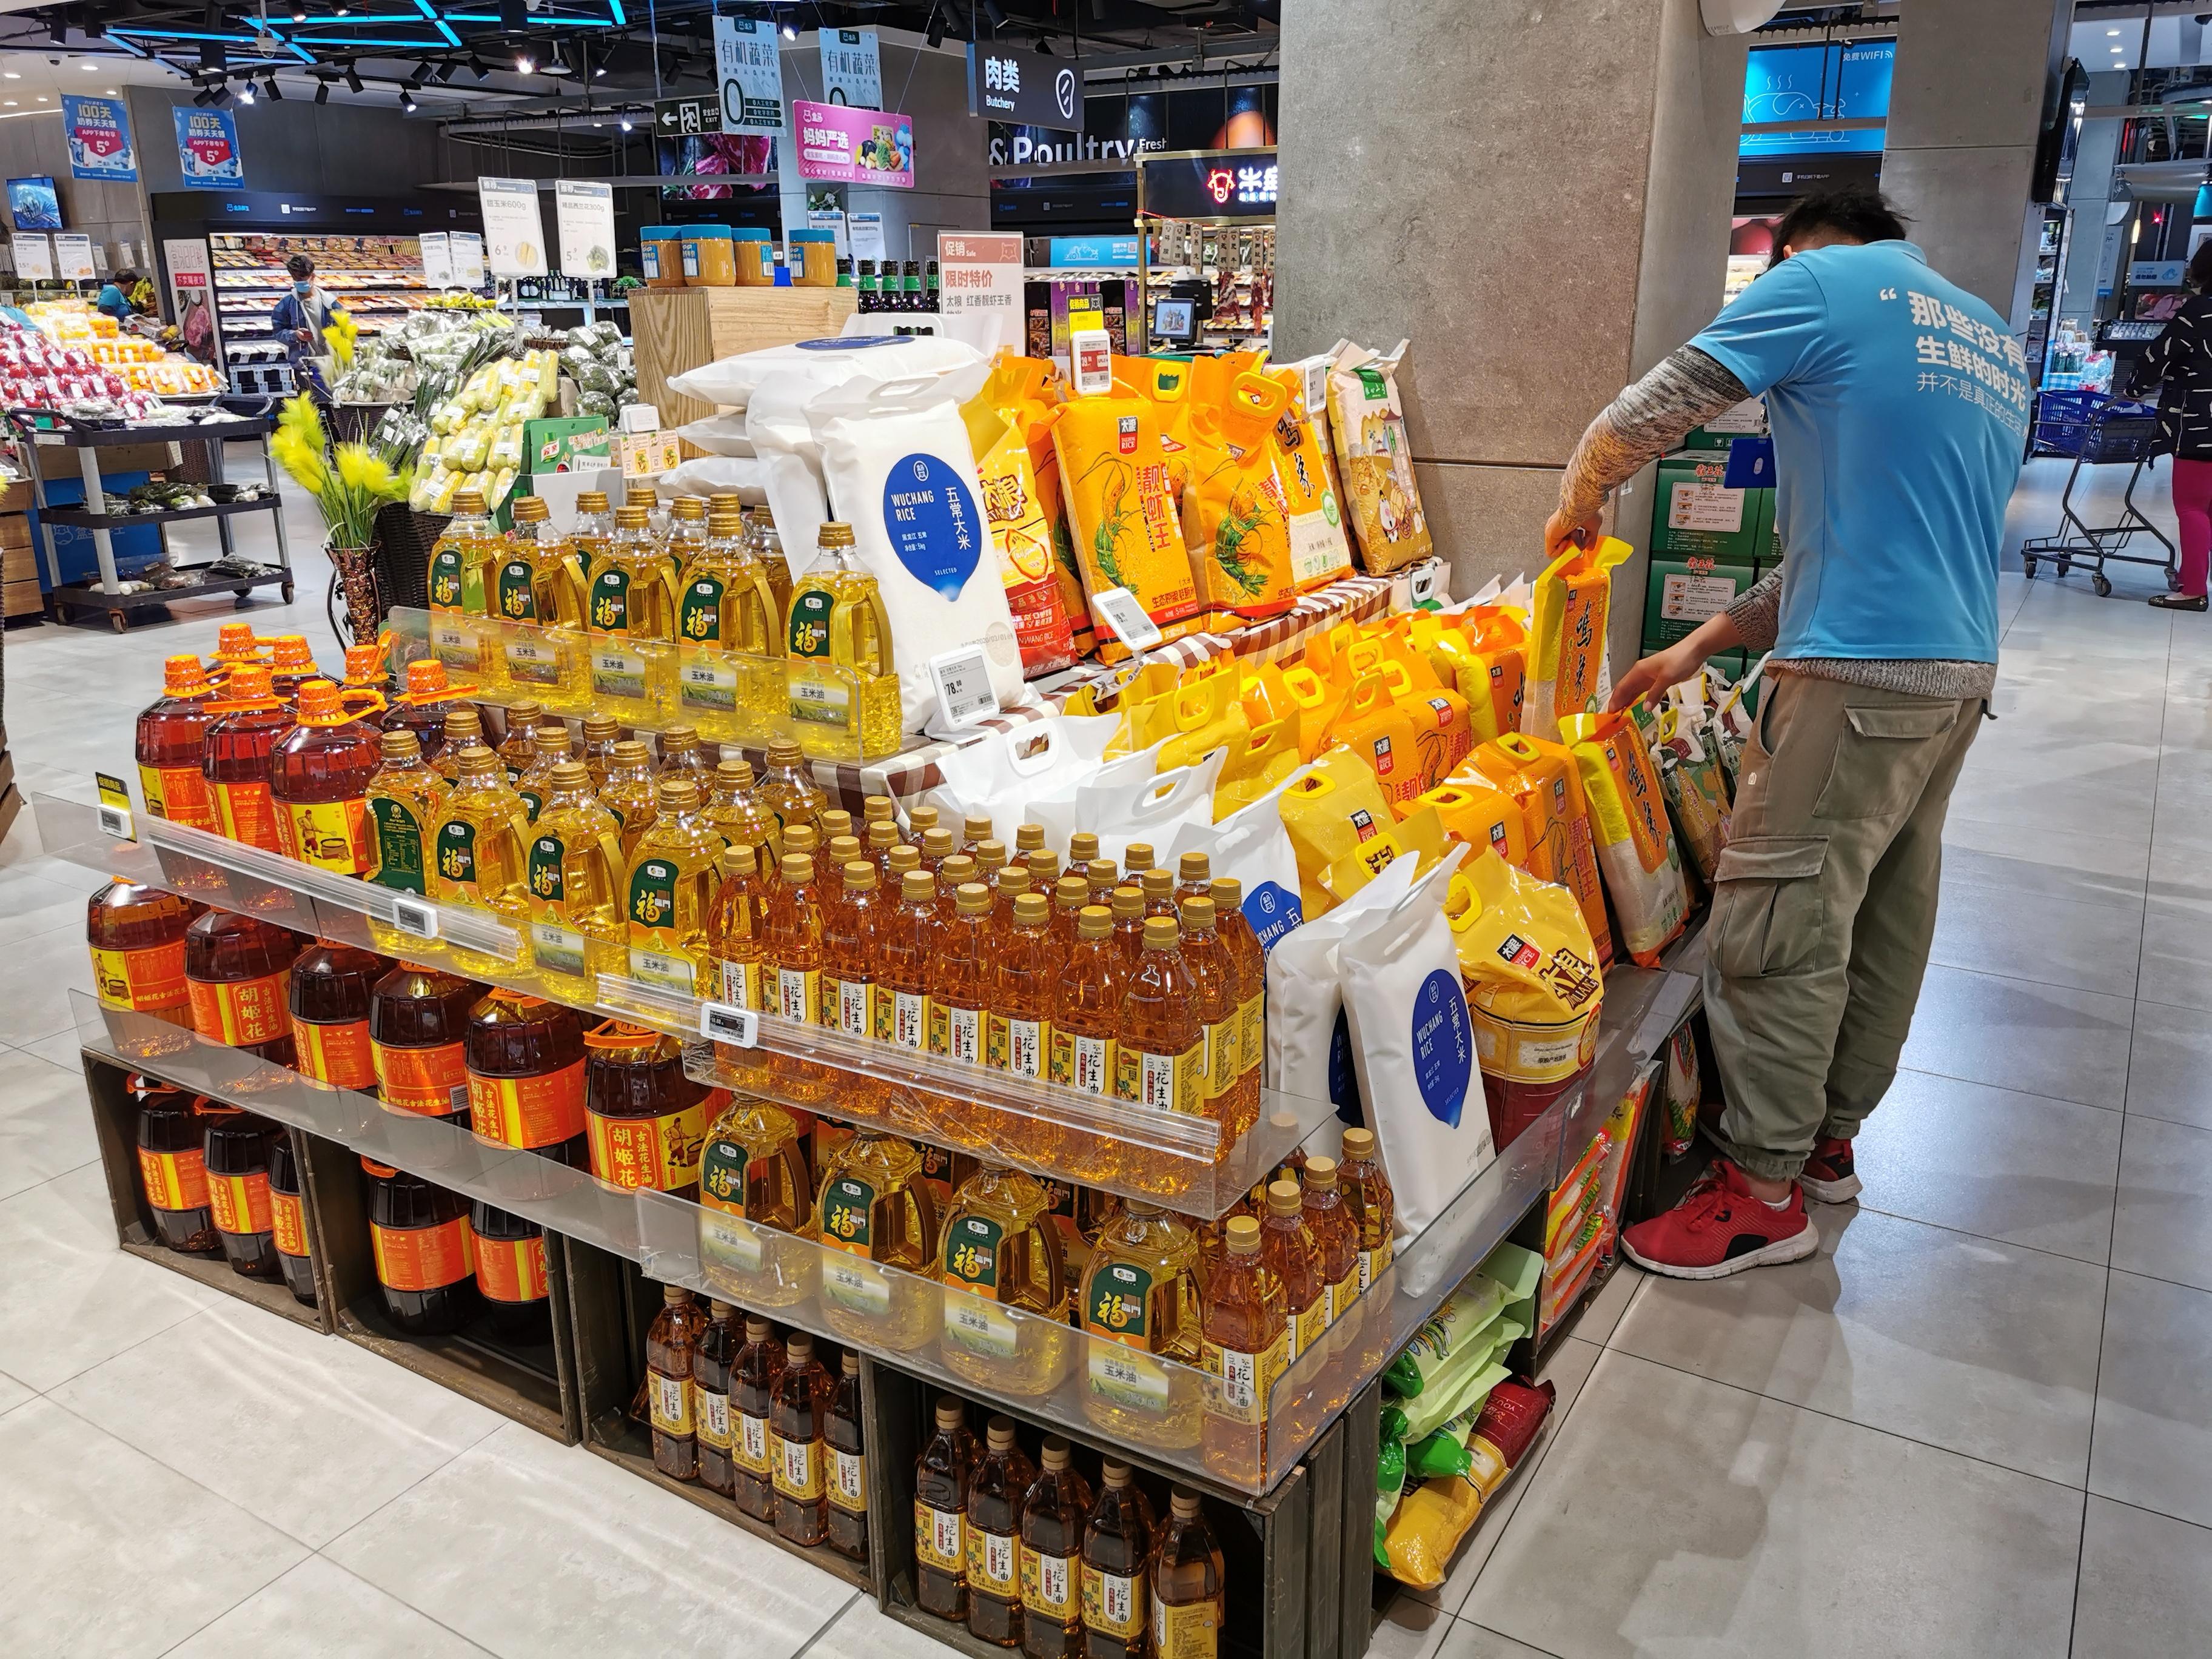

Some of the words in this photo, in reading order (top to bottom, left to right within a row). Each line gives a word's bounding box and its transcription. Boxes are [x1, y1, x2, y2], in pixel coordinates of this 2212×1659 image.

[722, 39, 774, 67] 有机蔬菜
[827, 50, 876, 76] 有机蔬菜
[1843, 50, 1883, 61] 免费WIFI
[985, 56, 1020, 93] 肉类
[986, 95, 1016, 112] Butchery
[803, 126, 849, 150] 妈妈严选
[486, 199, 526, 210] 甜玉米600g
[945, 241, 965, 257] 促销
[945, 270, 993, 288] 限时特价
[947, 295, 962, 307] 太粮
[967, 295, 1012, 307] 红香靓虾王香
[1915, 335, 2026, 412] 生鲜的时光
[1121, 419, 1136, 433] 太粮
[1121, 441, 1136, 449] RICE
[891, 490, 934, 508] WUCHANG
[1142, 464, 1171, 549] 靓虾王
[896, 507, 916, 522] RICE
[945, 487, 971, 550] 五常大米
[934, 568, 957, 576] SELECTED
[515, 648, 537, 658] 玉米油
[602, 659, 625, 670] 玉米油
[692, 671, 715, 682] 玉米油
[800, 686, 825, 699] 玉米油
[1431, 698, 1449, 710] 太粮
[1376, 739, 1390, 755] 太粮
[1379, 761, 1392, 771] RICE
[1492, 825, 1504, 842] 太粮
[541, 932, 563, 947] 玉米油
[1502, 937, 1523, 959] 太粮
[642, 959, 669, 973] 玉米油
[239, 986, 266, 1039] 胡姬花
[261, 986, 280, 1031] 古法花生油
[789, 984, 802, 1023] 花生油
[905, 1010, 919, 1048] 花生油
[1416, 1010, 1443, 1044] WUCHANG
[1449, 996, 1466, 1064] 五常大米
[962, 1025, 974, 1065] 花生油
[1420, 1037, 1433, 1060] RICE
[1022, 1037, 1035, 1078] 花生油
[1087, 1053, 1101, 1094] 花生油
[1444, 1087, 1460, 1106] SELECTED
[485, 1088, 500, 1139] 古法花生油
[613, 1127, 638, 1189] 胡姬花
[636, 1131, 653, 1185] 古法花生油
[713, 1229, 739, 1247] 玉米油
[835, 1271, 863, 1289] 玉米油
[958, 1314, 988, 1332] 玉米油
[1104, 1364, 1137, 1384] 玉米油
[669, 1390, 679, 1421] 花生油
[716, 1401, 726, 1435] 花生油
[752, 1424, 762, 1459] 花生油
[794, 1453, 804, 1487] 花生油
[847, 1463, 857, 1498] 花生油
[945, 1525, 956, 1557] 花生油
[997, 1549, 1009, 1581] 花生油
[1052, 1569, 1065, 1604] 花生油
[1116, 1588, 1128, 1624] 花生油
